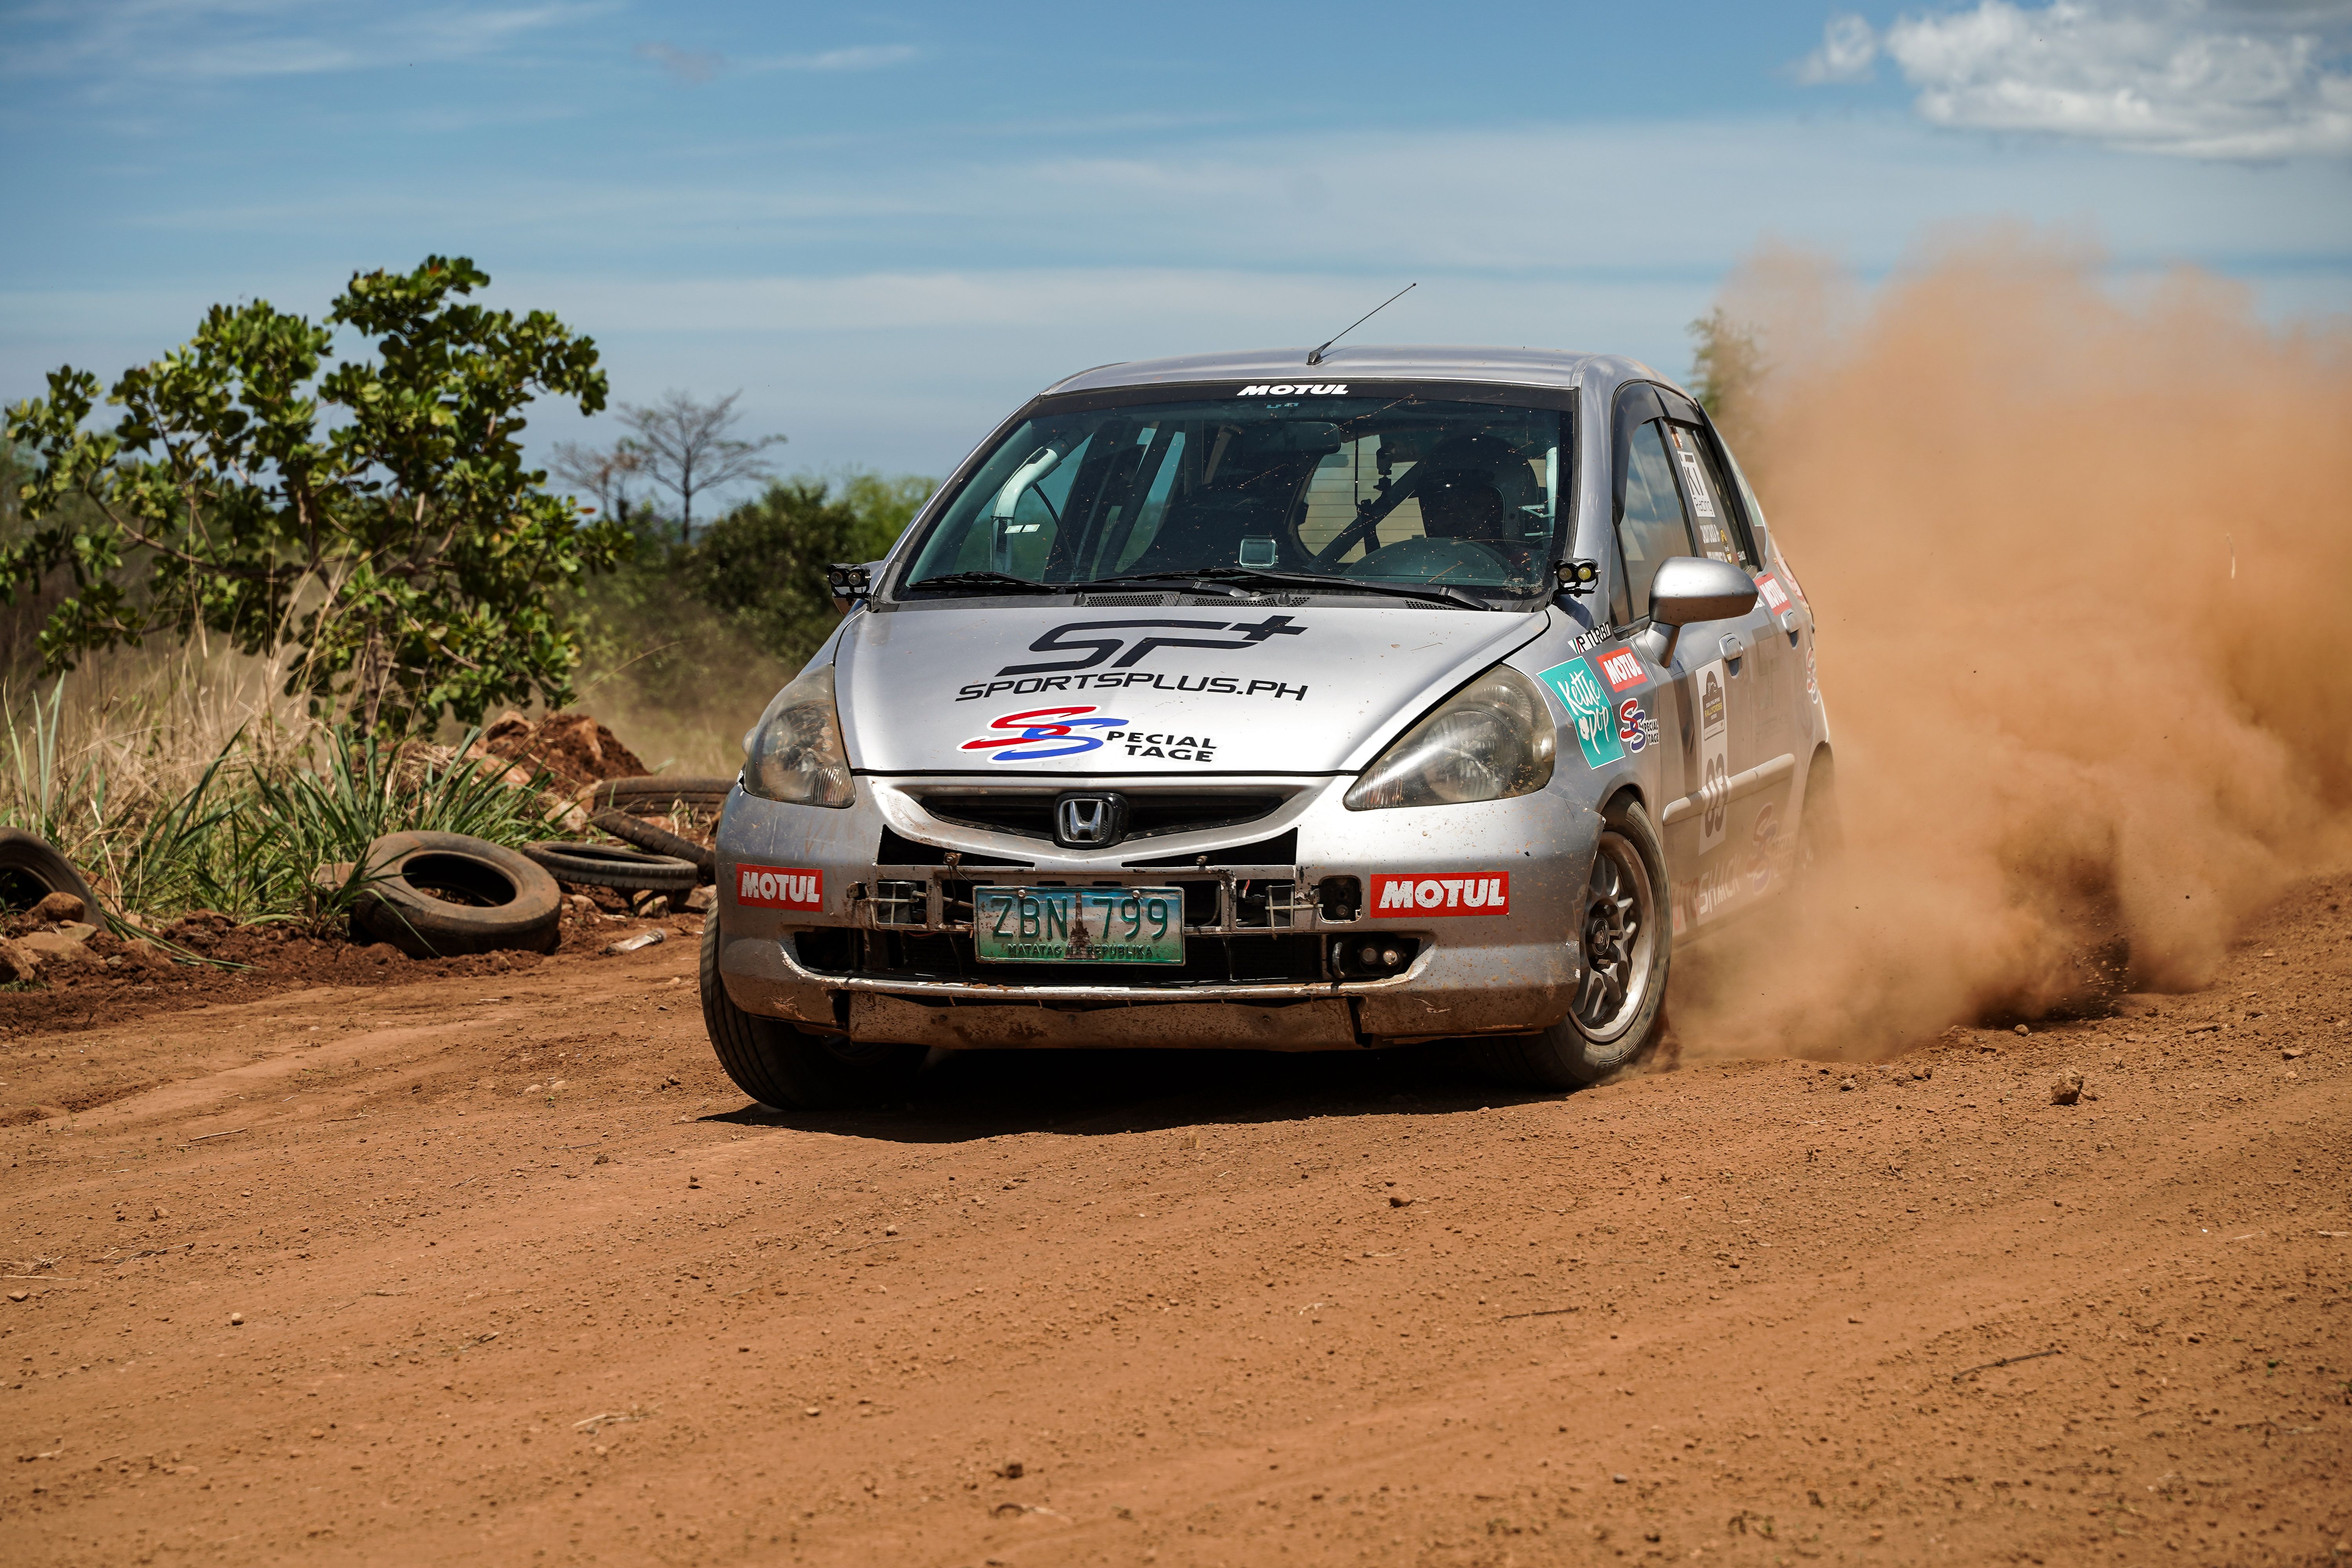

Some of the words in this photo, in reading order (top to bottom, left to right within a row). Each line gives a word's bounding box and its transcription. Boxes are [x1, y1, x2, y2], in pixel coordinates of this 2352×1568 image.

[1237, 385, 1348, 396] MOTUL
[1759, 578, 1788, 609] MOTUL
[1603, 653, 1642, 684] MOTUL
[955, 672, 1308, 701] SPORTSPLUS.PH
[1557, 670, 1600, 716] Kettle
[1704, 702, 1722, 718] RALLYCROSS
[1705, 753, 1728, 838] 03
[741, 871, 820, 902] MOTUL
[1379, 879, 1505, 908] MOTUL
[1672, 853, 1741, 930] UTOSHACK
[991, 895, 1068, 939] ZBN
[1092, 896, 1168, 940] 799
[1007, 944, 1062, 955] MATATAG
[1086, 944, 1153, 956] REPUBLIKA
